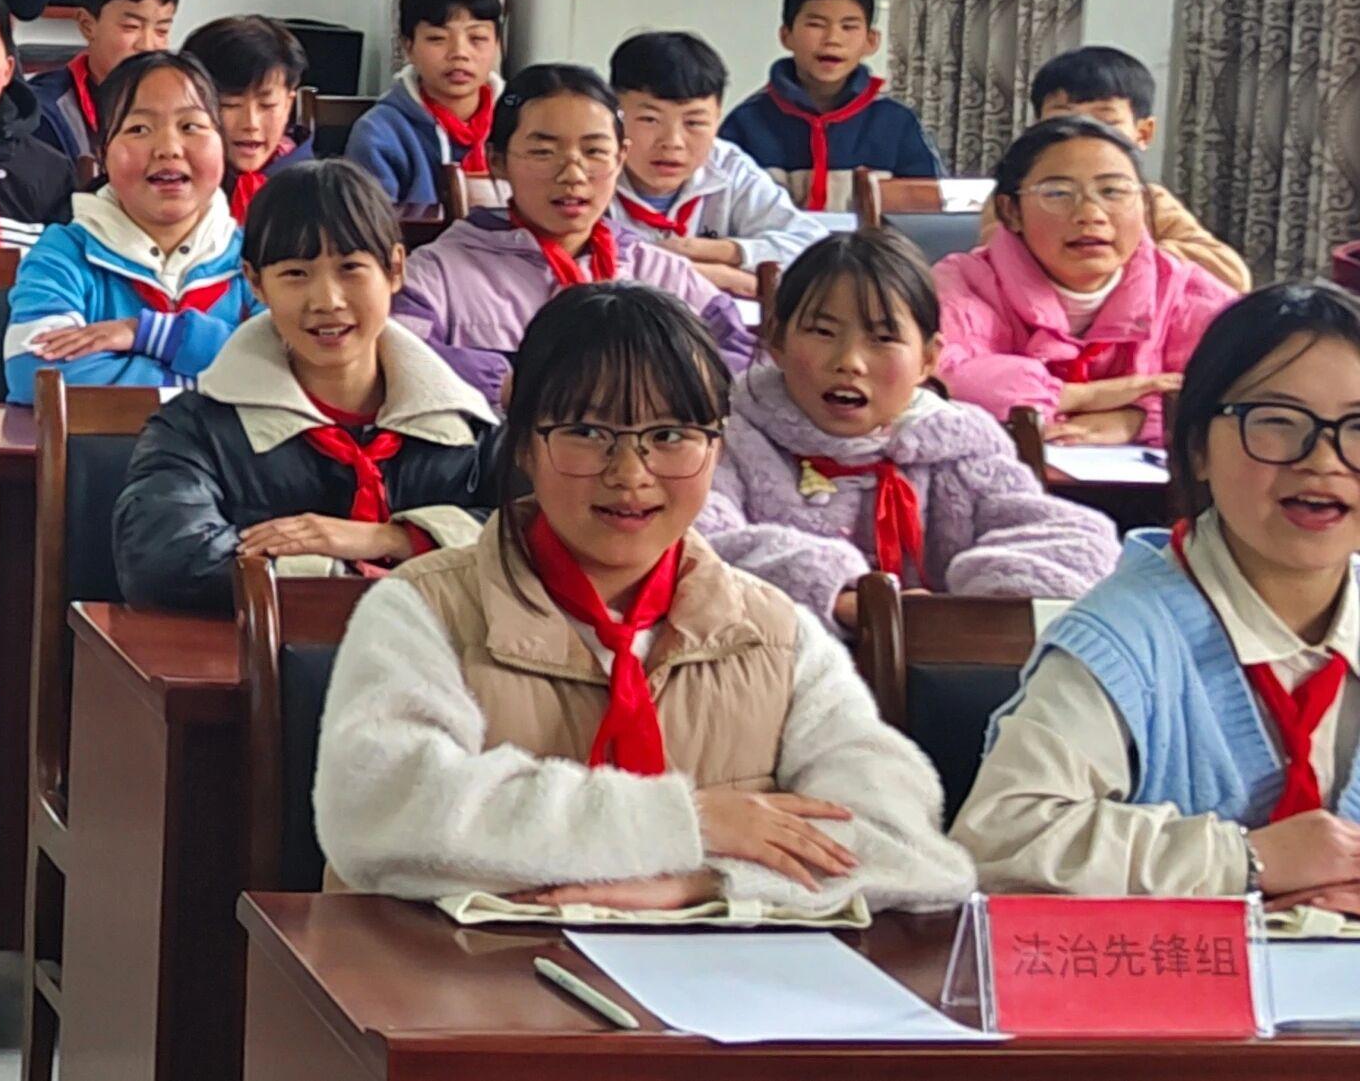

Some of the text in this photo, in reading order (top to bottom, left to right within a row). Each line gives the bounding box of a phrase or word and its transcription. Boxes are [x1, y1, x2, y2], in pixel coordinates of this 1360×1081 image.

[1014, 932, 1239, 978] 法治先锋组
